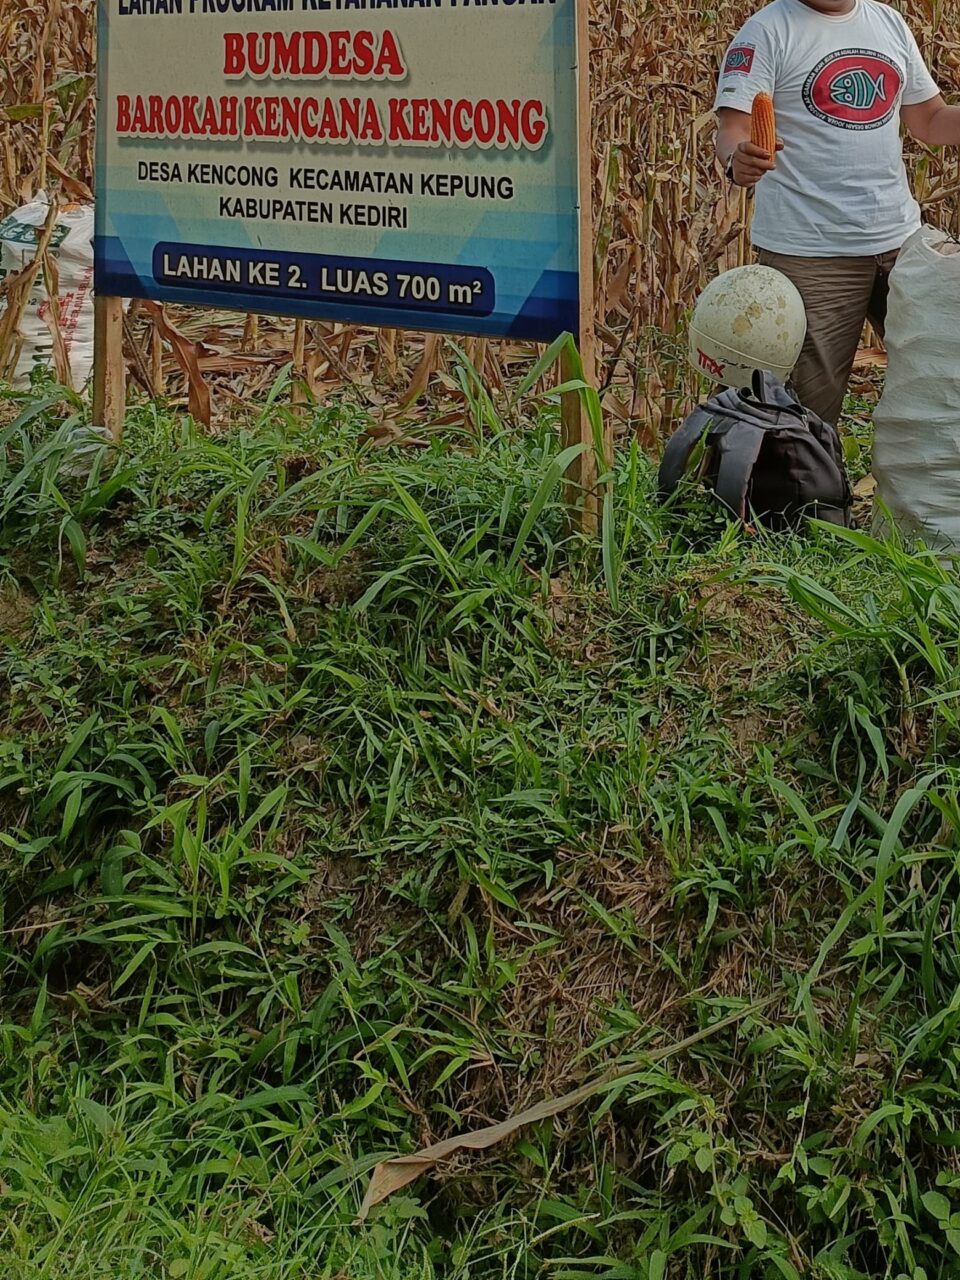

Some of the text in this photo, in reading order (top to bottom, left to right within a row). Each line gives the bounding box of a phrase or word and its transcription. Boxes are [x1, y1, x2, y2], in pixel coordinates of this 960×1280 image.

[223, 29, 404, 76] BUMDESA
[116, 95, 547, 145] BAROKAH KENCANA KENCONG
[138, 160, 514, 200] DESA KENCONG KECAMATAN KEPUNG
[218, 196, 408, 229] KABUPATEN KEDIRI
[163, 253, 241, 283] LAHAN
[247, 261, 281, 288] KE
[287, 264, 308, 289] 2.
[320, 267, 389, 297] LUAS
[396, 274, 440, 301] 700
